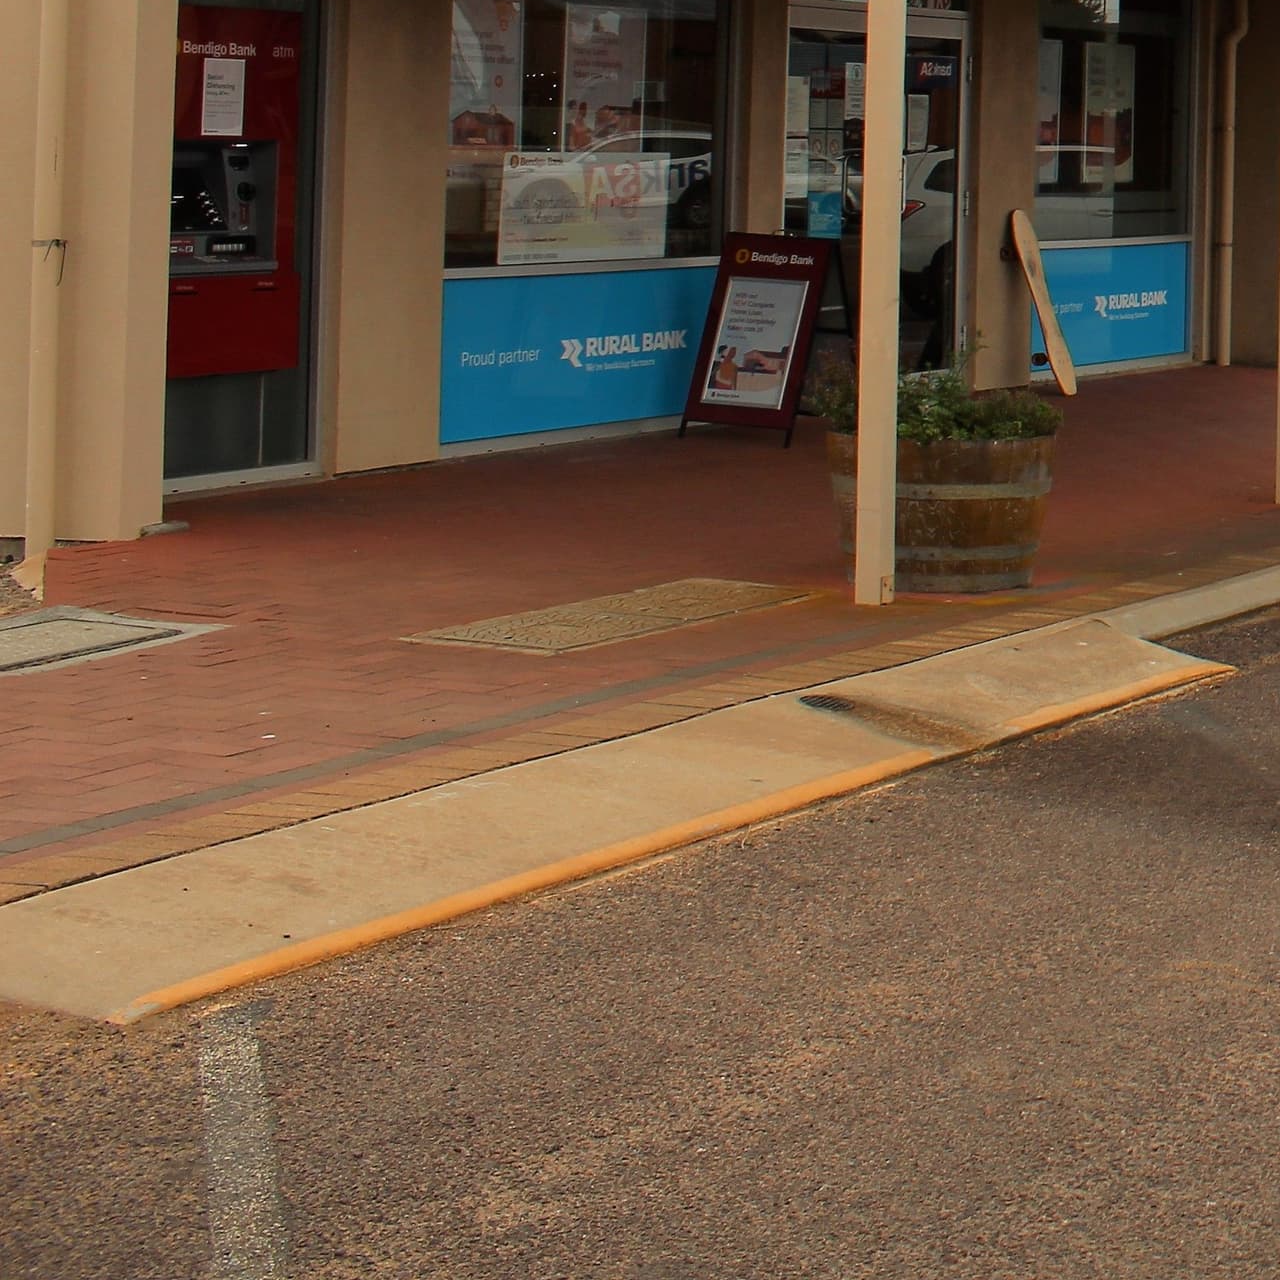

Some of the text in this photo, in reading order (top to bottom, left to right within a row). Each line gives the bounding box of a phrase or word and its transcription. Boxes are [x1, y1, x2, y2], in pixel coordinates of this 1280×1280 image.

[183, 40, 295, 58] Bendigo Bank atm
[751, 251, 815, 266] Bendigo Bank
[1108, 290, 1168, 310] RURAL BANK
[585, 329, 688, 358] RURAL BANK
[461, 347, 541, 367] Proud partner
